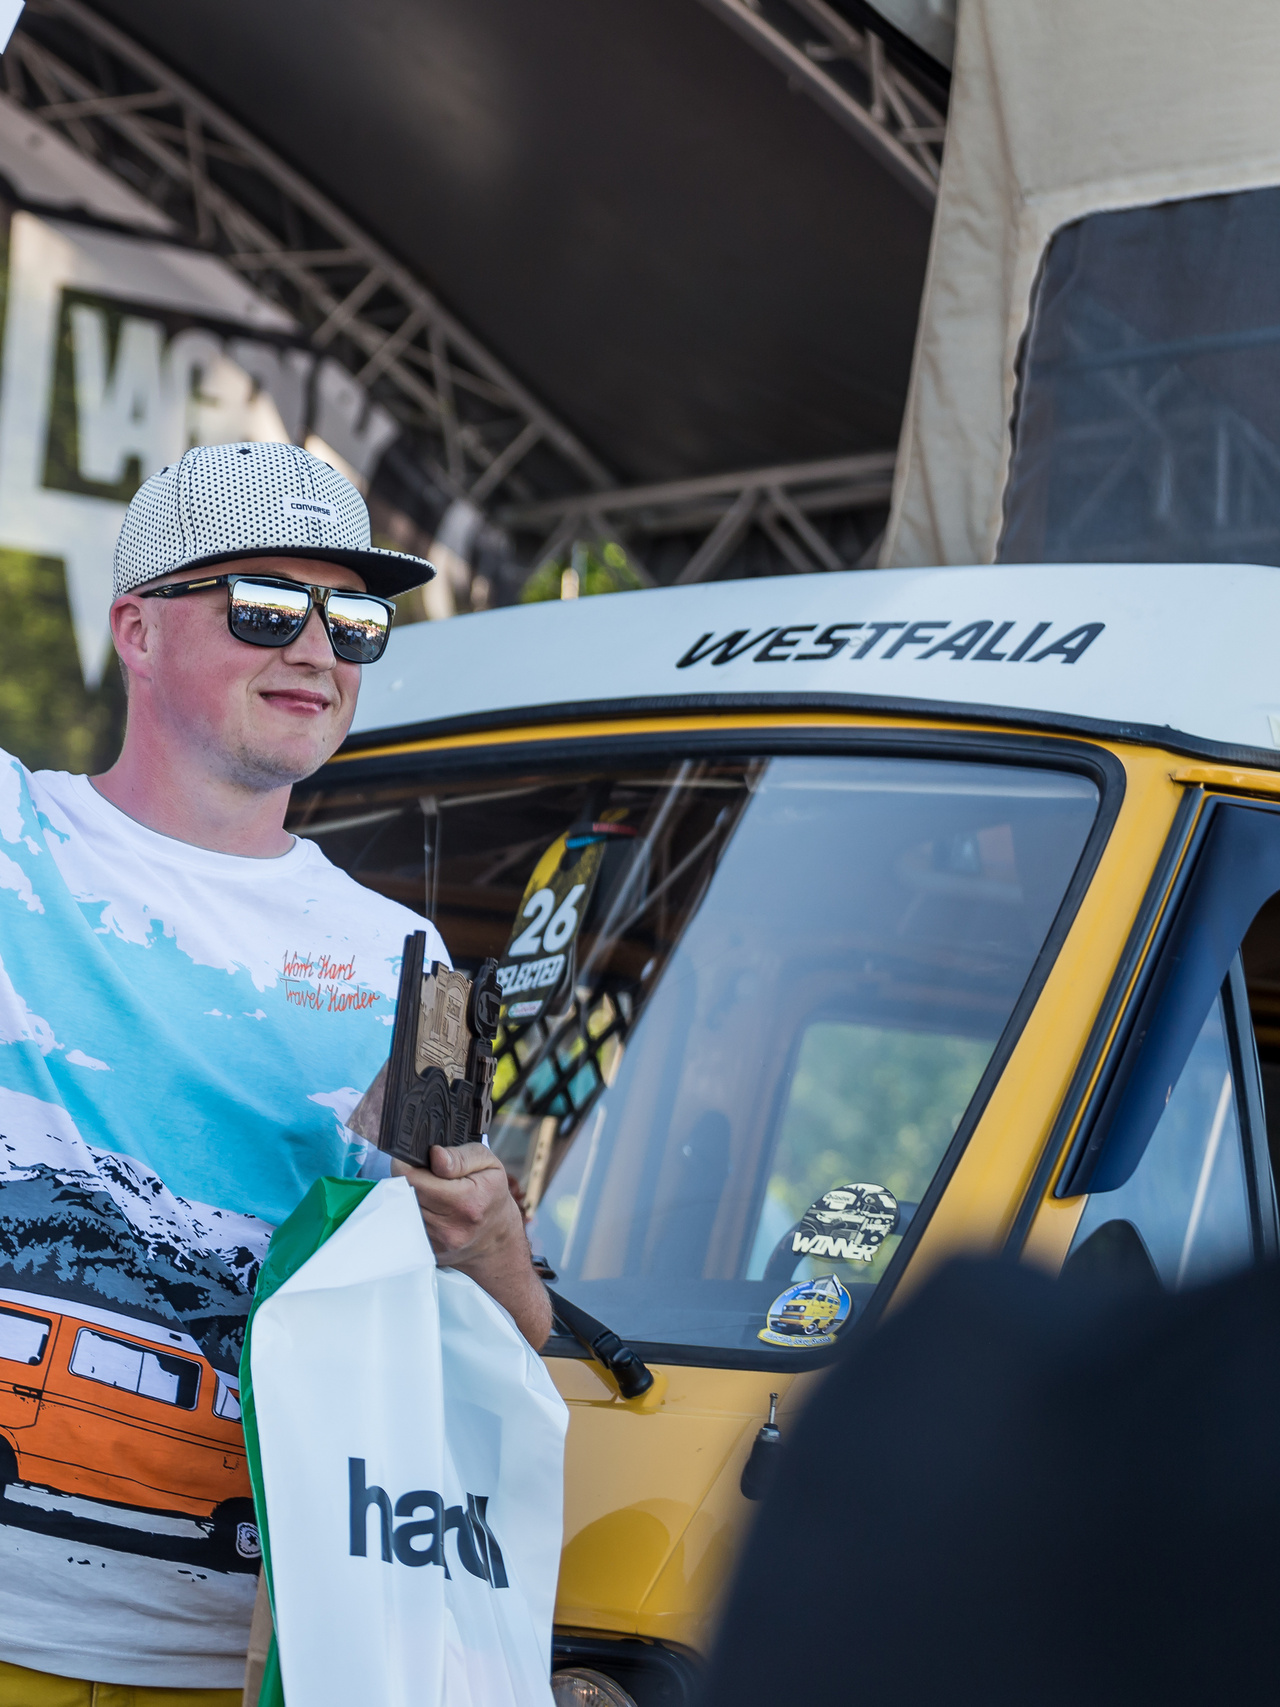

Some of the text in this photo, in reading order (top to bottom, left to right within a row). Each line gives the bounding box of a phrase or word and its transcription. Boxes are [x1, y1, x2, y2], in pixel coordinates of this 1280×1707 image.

[290, 502, 331, 516] CONVERSE
[676, 620, 1106, 668] WESTFALIA
[508, 883, 587, 957] 26
[282, 949, 357, 981] Work Hard
[280, 977, 380, 1013] Travel Harder
[792, 1231, 878, 1262] WINNER
